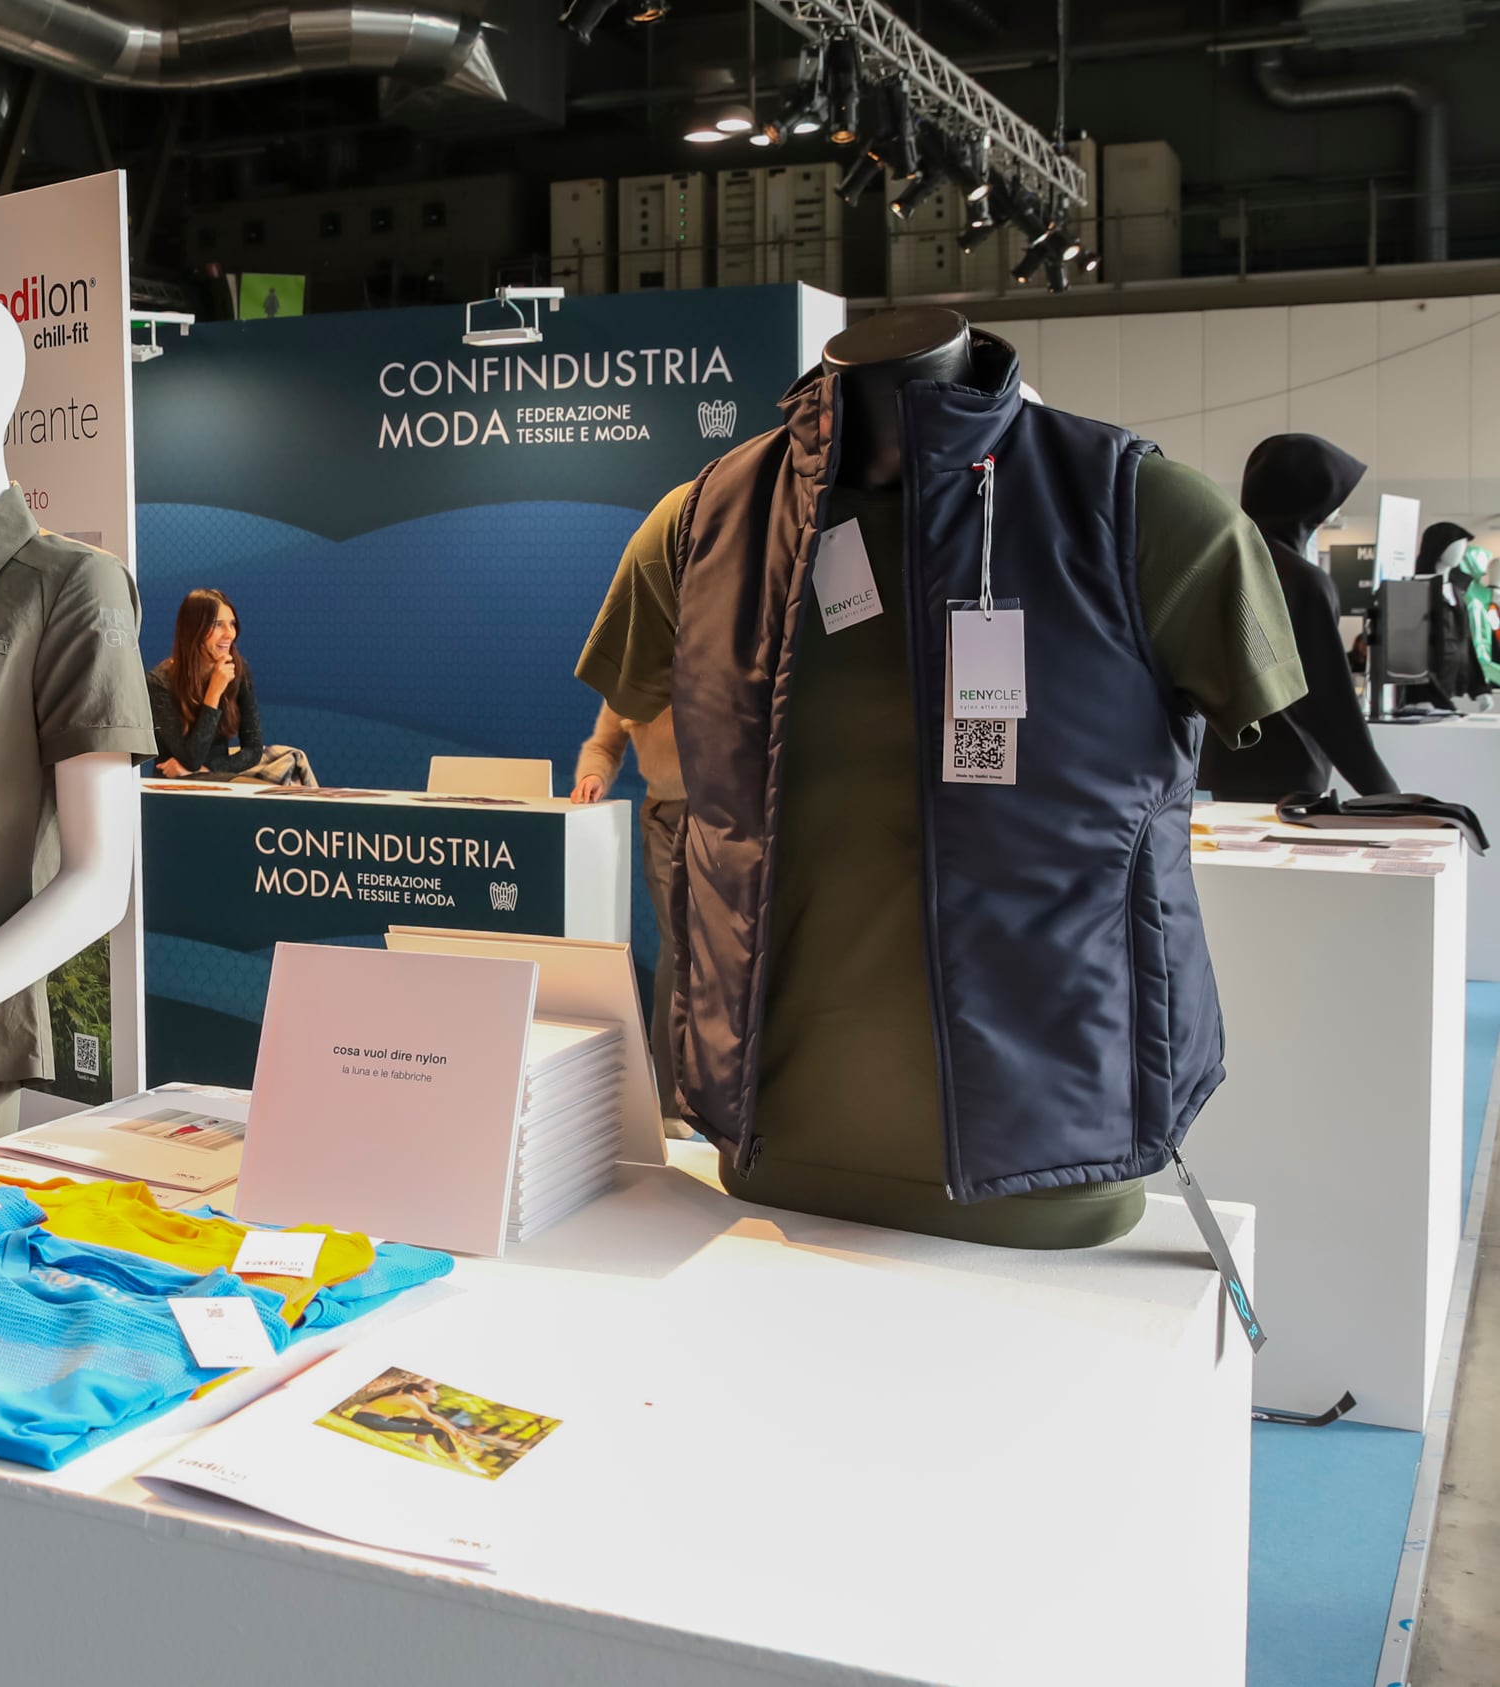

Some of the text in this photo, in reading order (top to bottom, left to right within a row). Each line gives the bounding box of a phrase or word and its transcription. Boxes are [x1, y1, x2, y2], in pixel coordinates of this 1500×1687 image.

[33, 322, 89, 350] chill-fit
[379, 345, 734, 397] CONFINDUSTRIA
[4, 397, 98, 446] irante
[516, 404, 631, 423] FEDERAZIONE
[378, 408, 510, 449] MODA
[516, 424, 651, 444] TESSILE E MODA
[255, 827, 515, 870] CONFINDUSTRIA
[255, 865, 353, 900] MODA
[357, 873, 441, 891] FEDERAZIONE
[357, 888, 455, 907] TESSILE E MODA
[333, 1045, 447, 1065] cosa vuol dire nylon
[342, 1065, 350, 1074] la
[352, 1065, 370, 1076] luna
[380, 1069, 388, 1078] le
[390, 1069, 432, 1083] fabbriche
